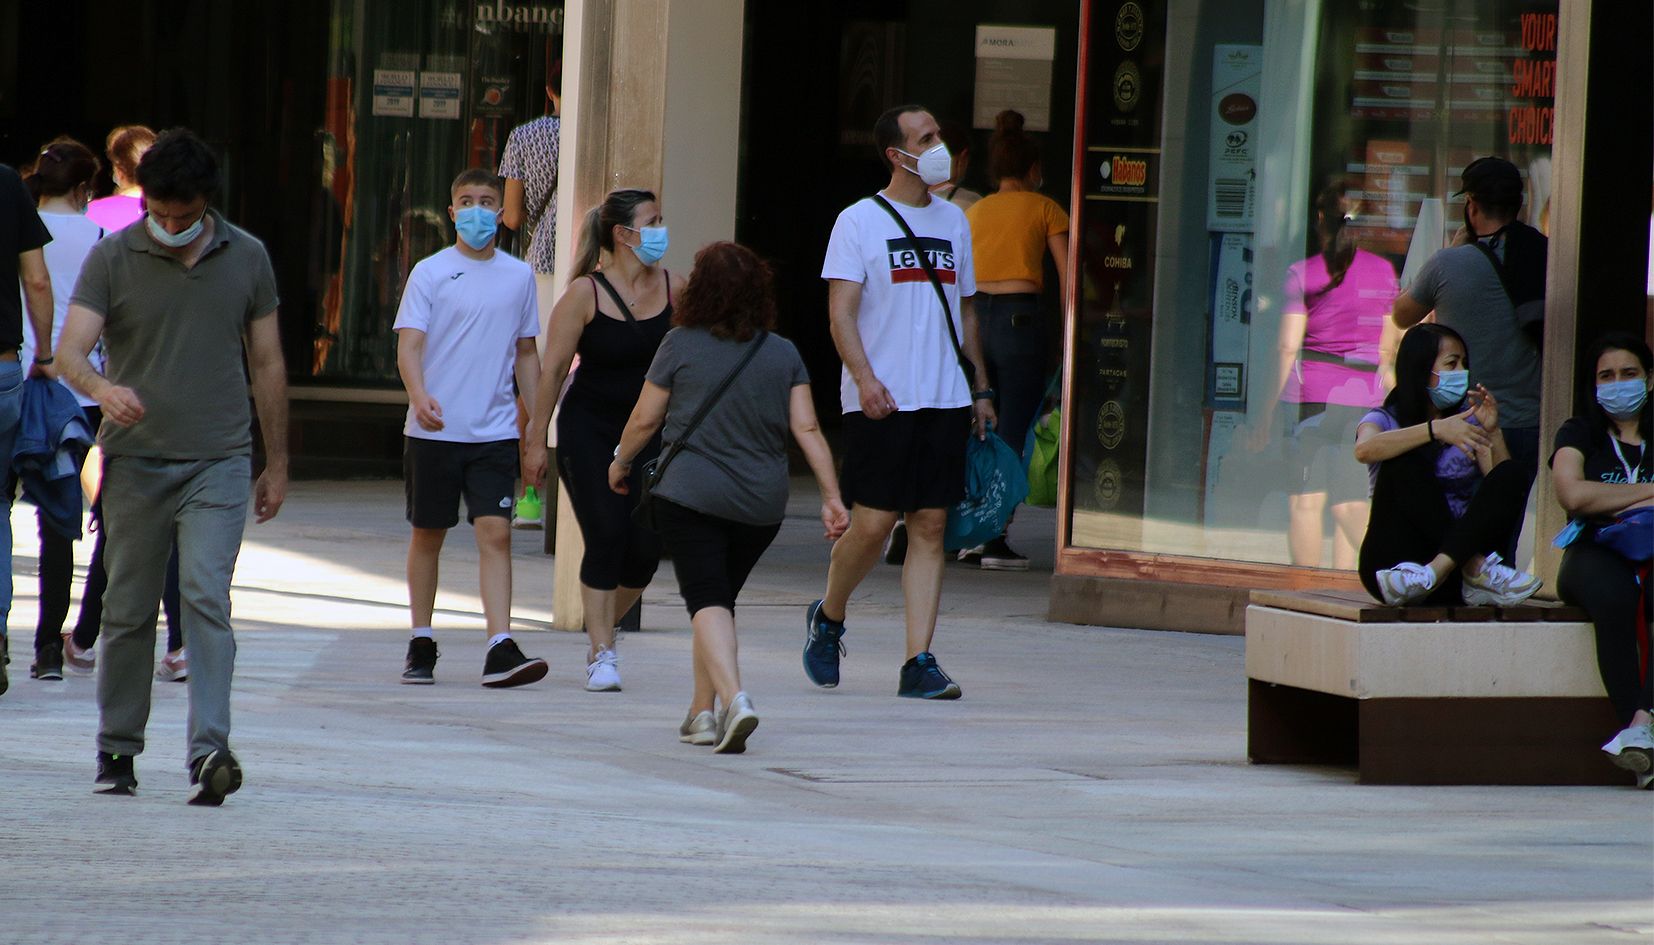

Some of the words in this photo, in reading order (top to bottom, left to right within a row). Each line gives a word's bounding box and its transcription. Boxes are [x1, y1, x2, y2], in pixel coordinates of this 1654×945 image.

[1520, 13, 1555, 51] YOUR
[1512, 59, 1555, 97] SMART
[1508, 106, 1554, 144] CHOICE
[1112, 155, 1146, 185] Habanos
[1104, 256, 1132, 269] COHIBA
